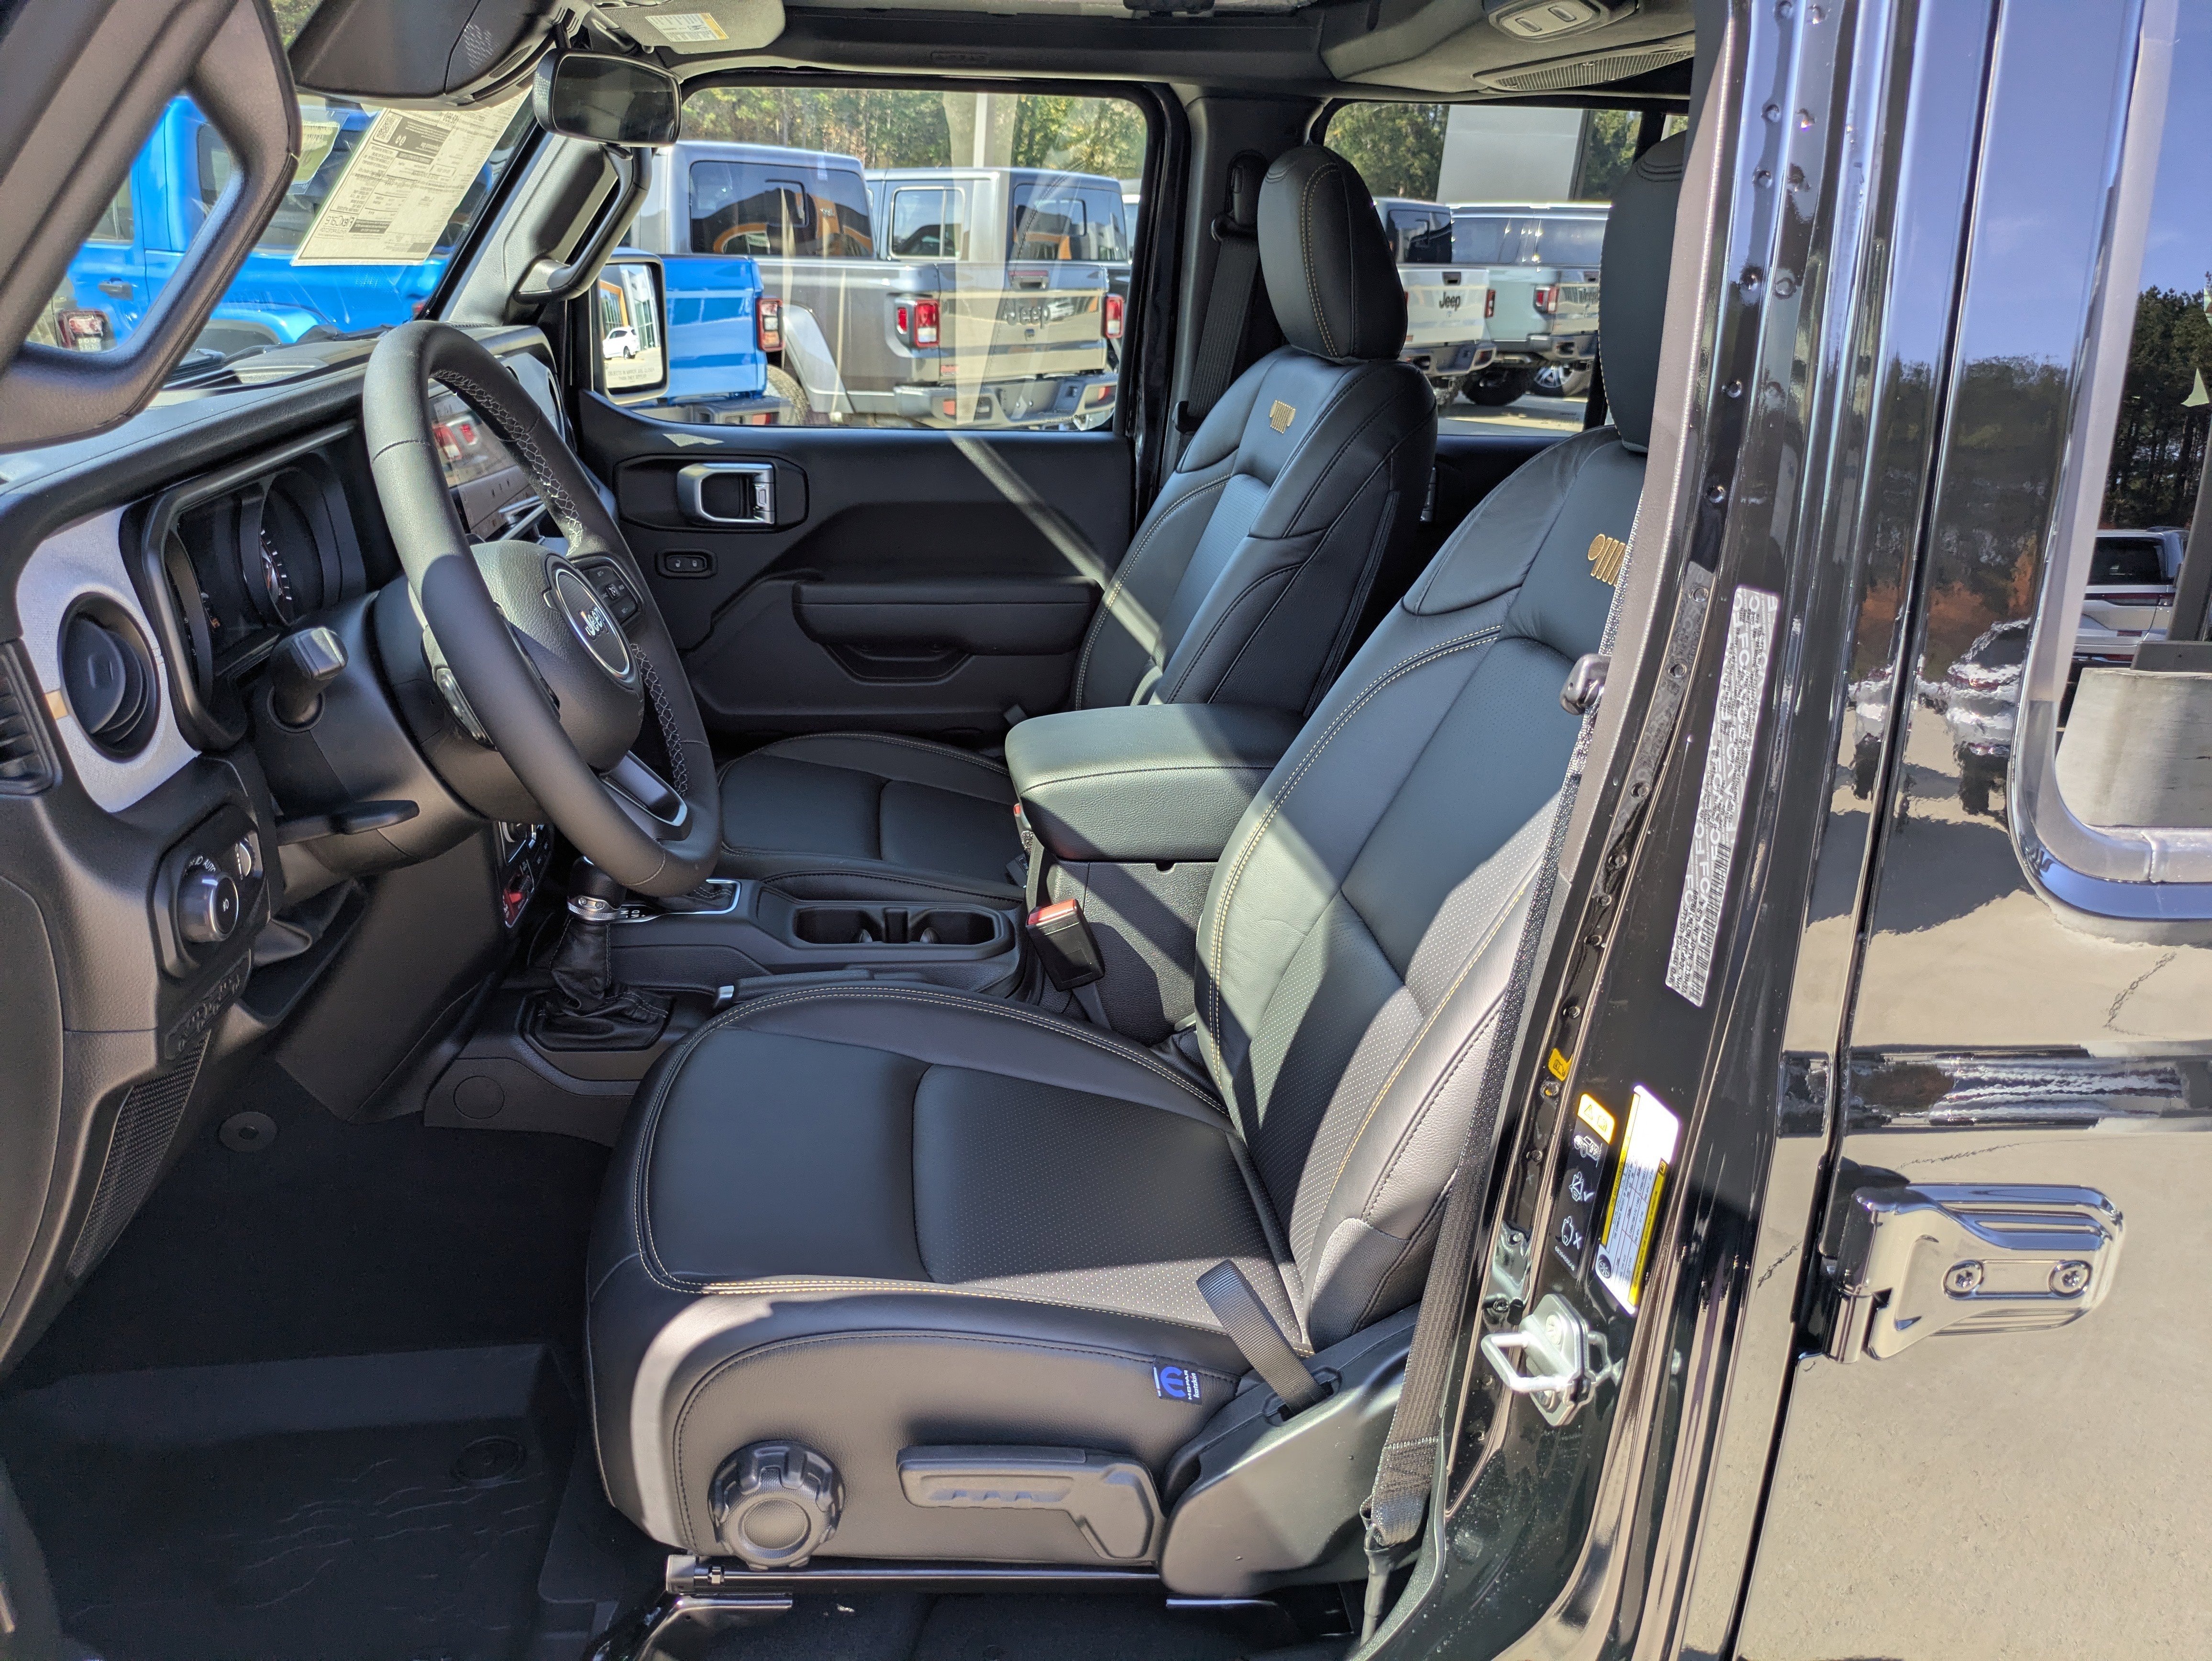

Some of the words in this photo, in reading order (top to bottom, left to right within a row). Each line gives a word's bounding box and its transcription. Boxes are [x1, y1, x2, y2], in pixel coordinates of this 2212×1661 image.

[1005, 299, 1051, 329] Jeep
[1438, 290, 1460, 311] Jeep
[1738, 740, 1746, 772] PREVENTION
[1755, 669, 1759, 677] ON
[1741, 738, 1750, 777] MANUFACTURE
[203, 859, 216, 872] AUTO
[1679, 921, 1684, 933] US
[1682, 961, 1691, 994] VEHICLE
[1688, 936, 1696, 961] MADE
[1695, 897, 1703, 922] U.S.A.
[1183, 1370, 1192, 1400] MOPAR
[1191, 1372, 1200, 1398] katzkin
